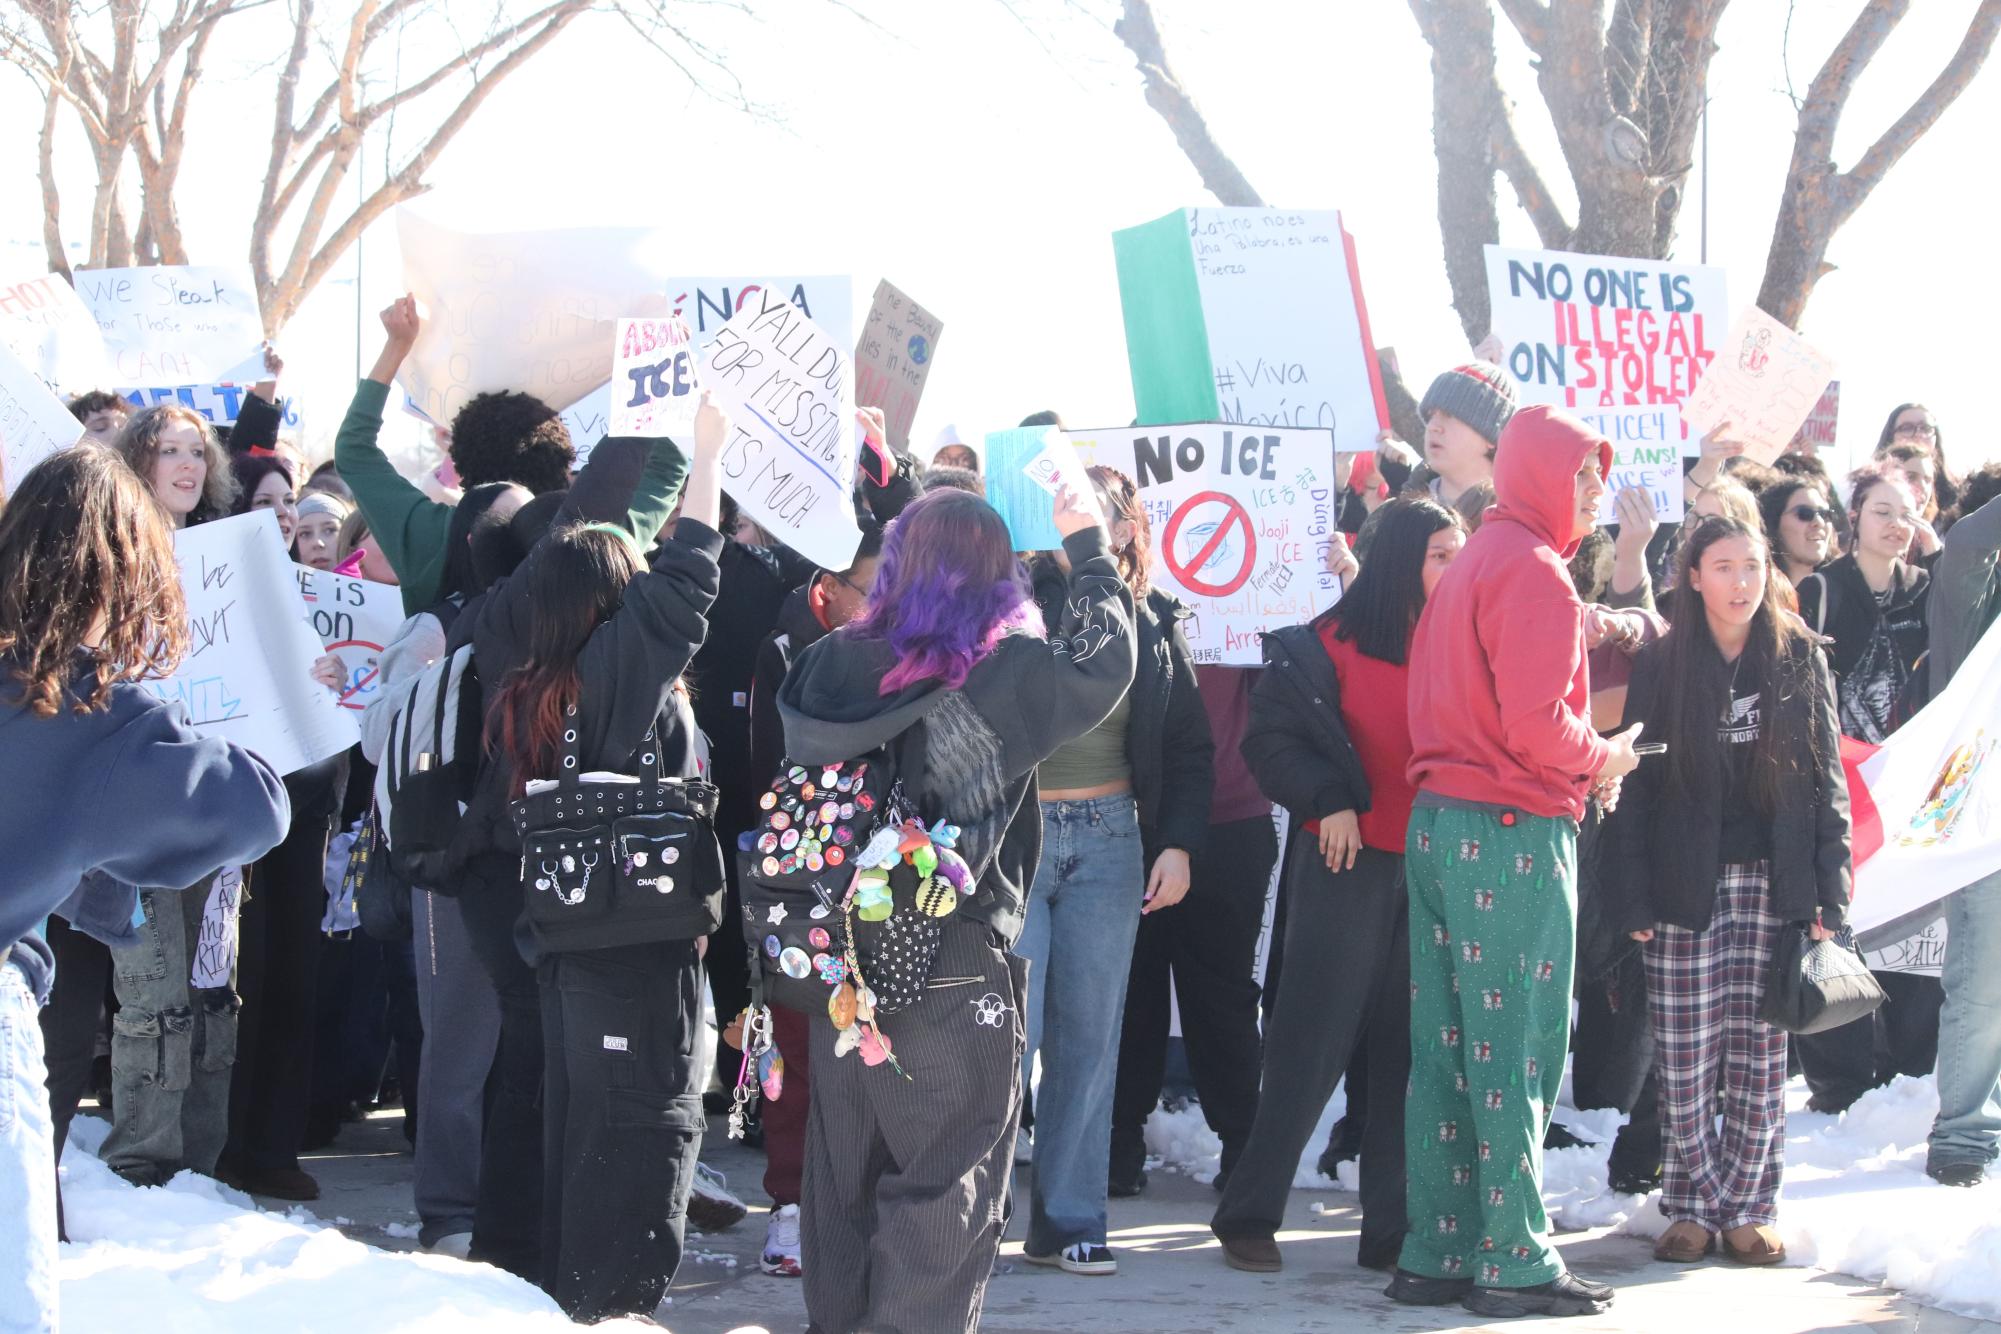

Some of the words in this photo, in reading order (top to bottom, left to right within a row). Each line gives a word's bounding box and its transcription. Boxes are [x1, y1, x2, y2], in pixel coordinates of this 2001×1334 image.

[1190, 208, 1252, 237] Latino
[1197, 257, 1246, 276] Fuerza
[81, 277, 132, 302] We
[1508, 259, 1574, 303] NO
[1584, 267, 1652, 310] ONE
[1658, 272, 1694, 313] IS
[193, 321, 219, 333] who
[1553, 300, 1716, 367] ILLEGAL
[861, 330, 881, 359] lies
[887, 348, 899, 371] in
[1509, 341, 1566, 386] ON
[702, 327, 764, 386] FOR
[750, 370, 847, 463] MISSING
[1133, 435, 1205, 489] NO
[1220, 431, 1281, 481] ICE
[1252, 487, 1278, 509] ICE
[1275, 543, 1304, 564] ICE
